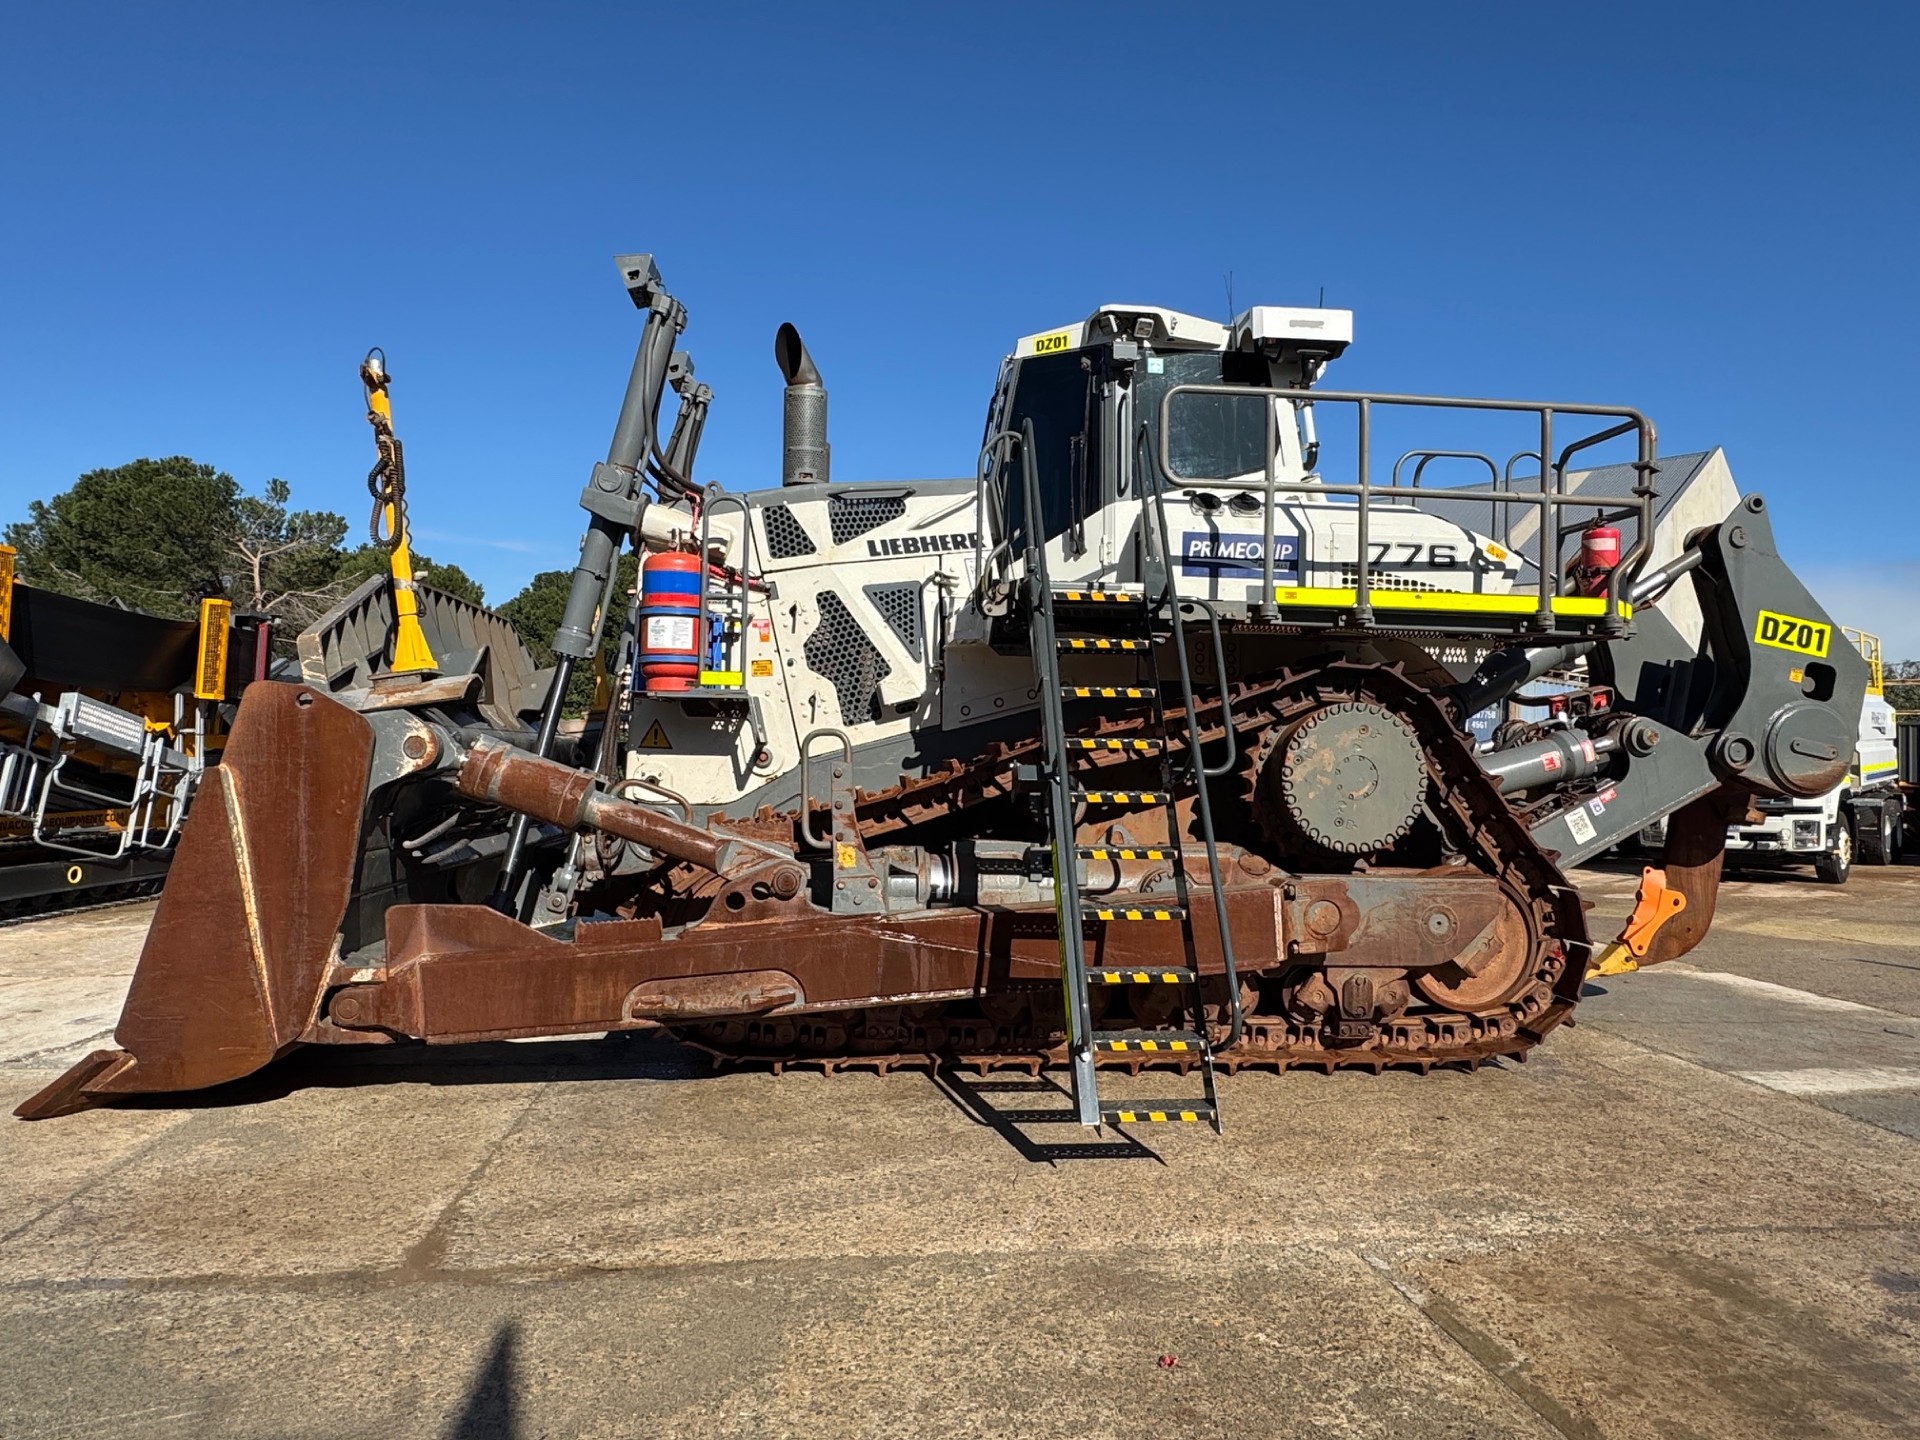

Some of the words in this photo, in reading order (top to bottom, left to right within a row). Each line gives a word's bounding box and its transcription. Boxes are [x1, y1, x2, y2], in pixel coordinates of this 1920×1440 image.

[1036, 335, 1068, 352] DZ01
[867, 533, 987, 557] LIEBHERR
[1188, 540, 1293, 560] PRIMEQIP
[1367, 542, 1458, 568] 776
[1761, 616, 1826, 652] DZ01
